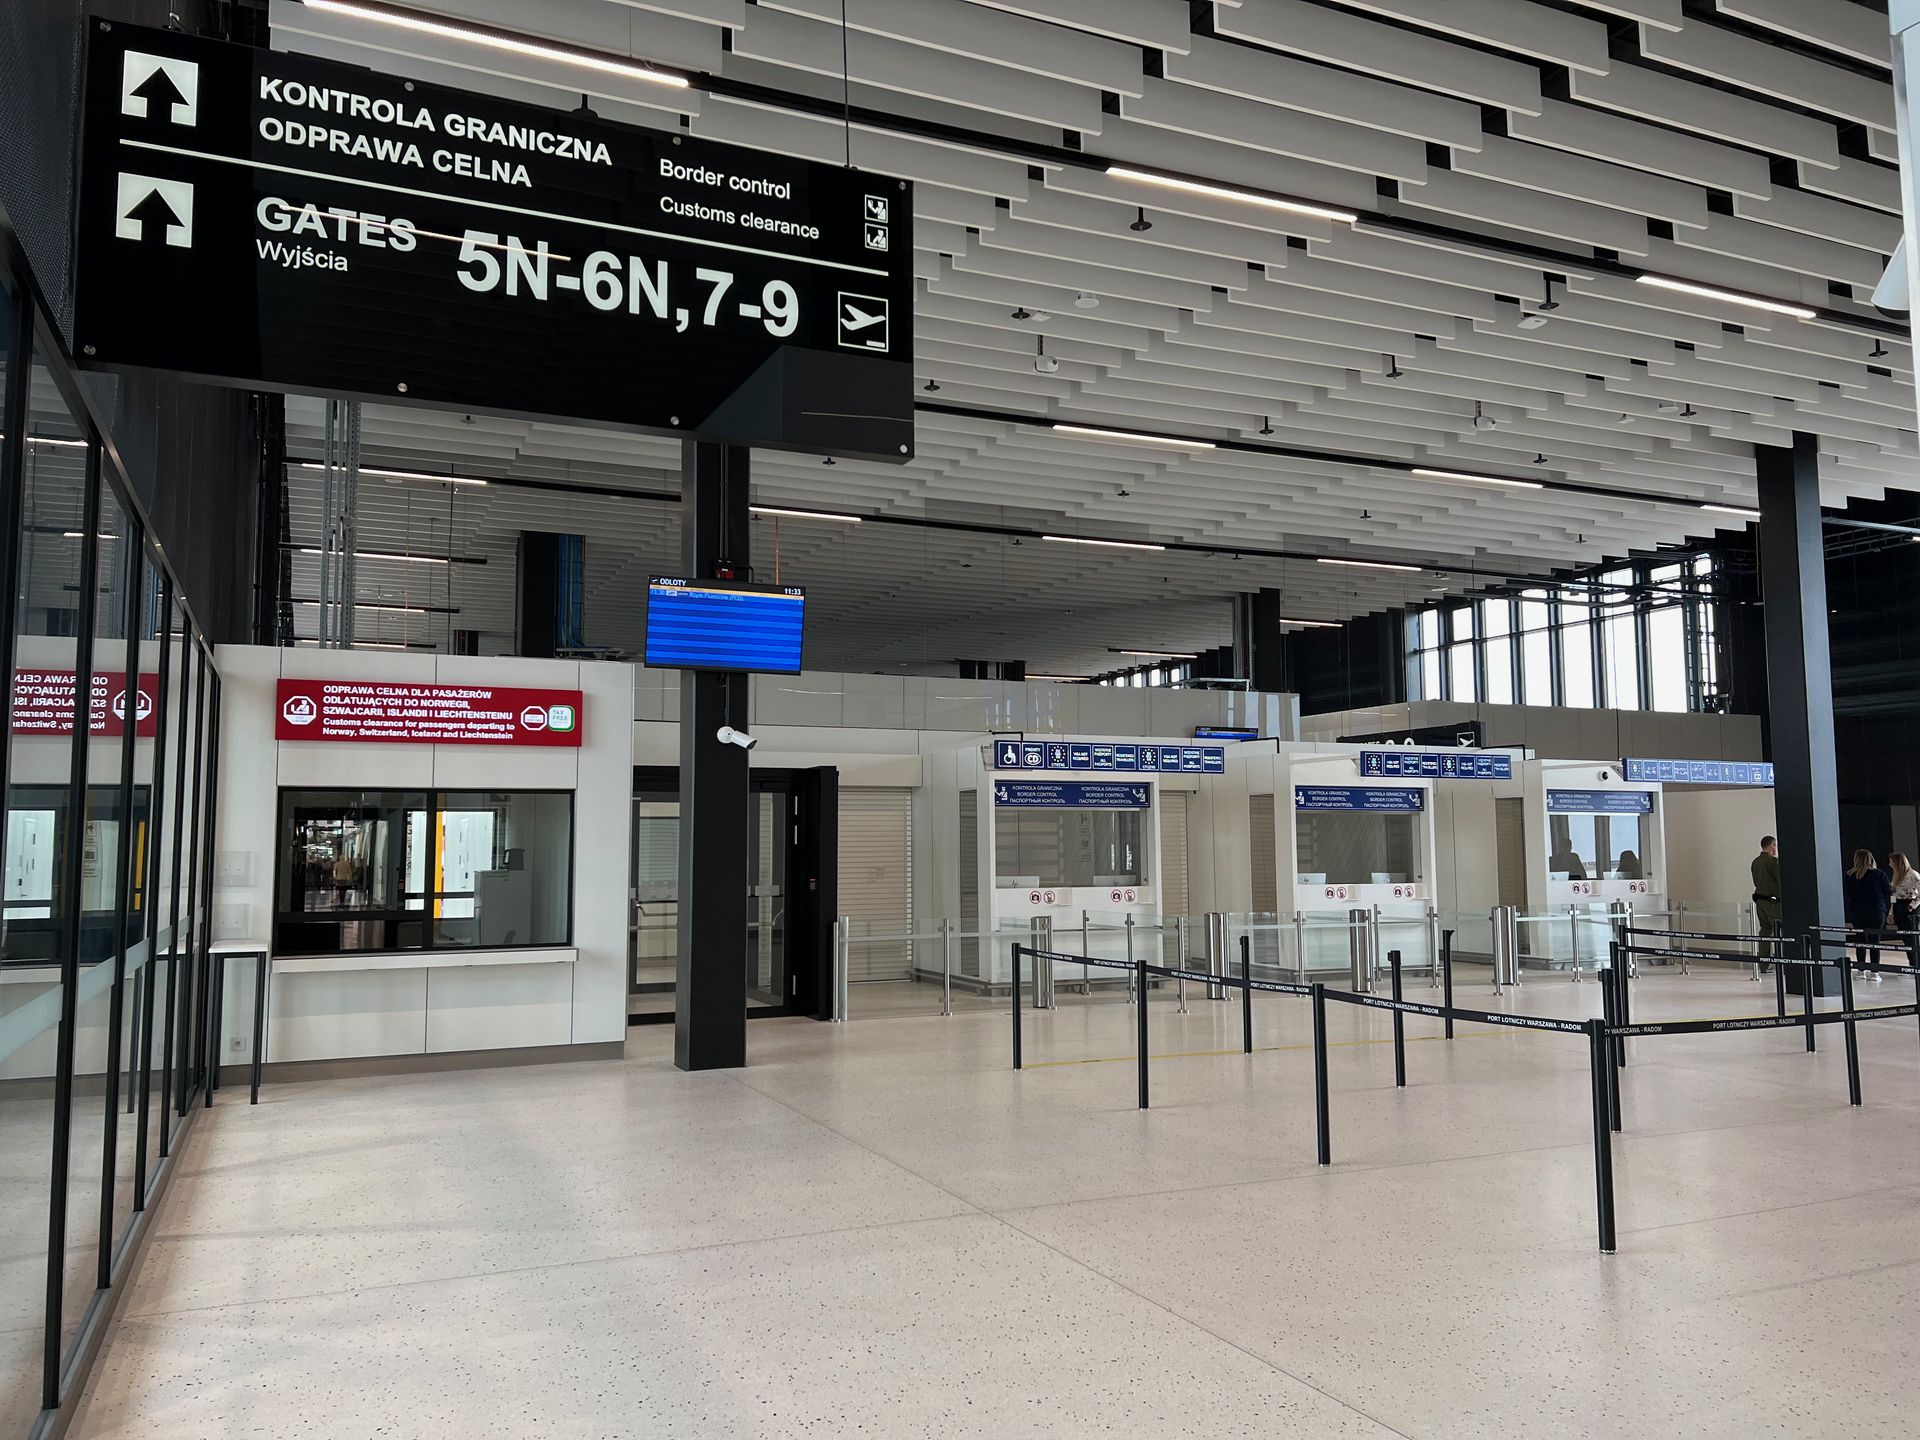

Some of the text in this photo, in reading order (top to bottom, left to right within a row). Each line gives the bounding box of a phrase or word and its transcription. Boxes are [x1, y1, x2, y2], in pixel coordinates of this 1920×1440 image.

[260, 76, 613, 166] KONTROLA GRANICZNA
[259, 117, 532, 187] ODPRAWA CELNA
[660, 158, 792, 200] Border control
[257, 196, 417, 251] GATES
[660, 196, 821, 240] Customs clearance
[256, 238, 348, 272] Wyjścia
[660, 578, 687, 587] ODLOTY
[784, 588, 801, 596] 11:33
[323, 685, 492, 699] ODPRAWA CELNA DLA PASAŻERÓW
[323, 695, 471, 709] ODLATUJĄCYCH DO NORWEGII,
[322, 706, 513, 720] SZWAJCARII, ISLANDII I LIECHTENSTEINU
[323, 717, 361, 728] Customs
[363, 718, 403, 729] clearance
[405, 719, 417, 728] for
[418, 721, 466, 732] passengers
[468, 721, 505, 732] departing
[506, 723, 515, 731] to
[322, 727, 513, 740] Norway, Switzerland, Iceland and Liechtenstein
[1027, 755, 1038, 763] CD
[1375, 1000, 1395, 1008] LOTNICZY
[1395, 1003, 1419, 1012] WARSZAWA
[1501, 1017, 1526, 1025] LOTNICZY
[1527, 1019, 1557, 1028] WARSZAWA
[1750, 1019, 1776, 1027] WARSZAWA
